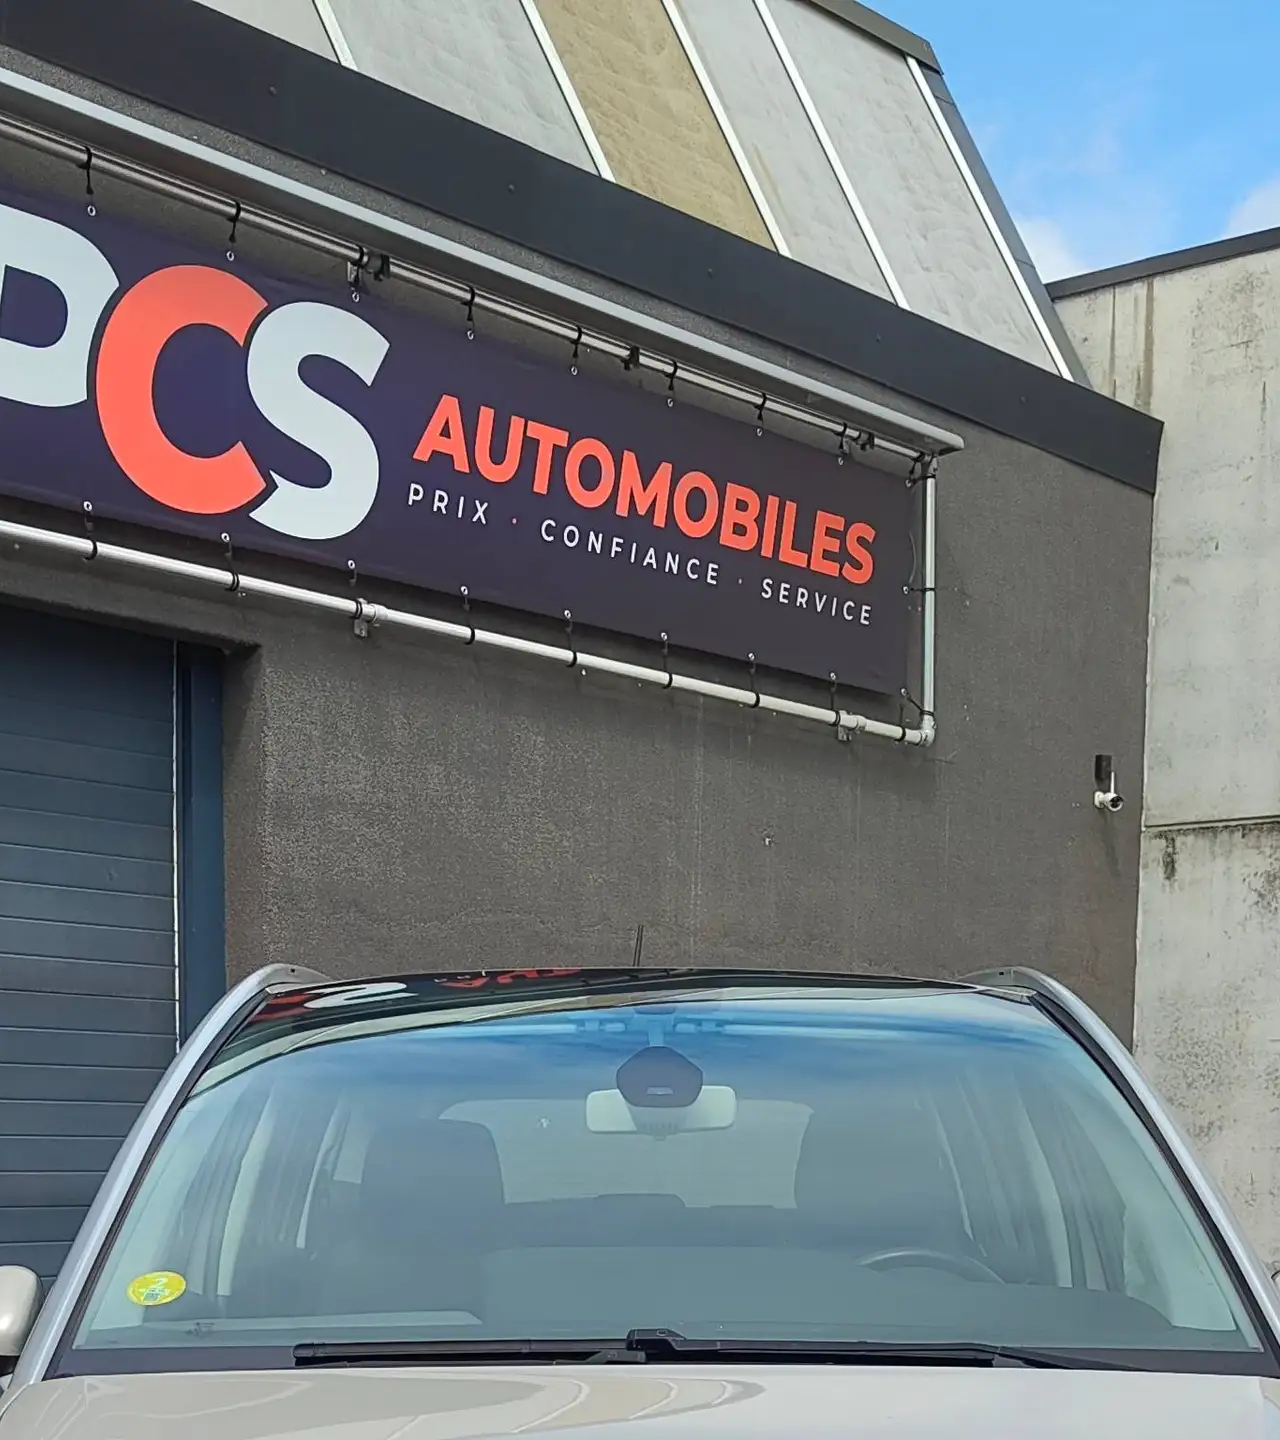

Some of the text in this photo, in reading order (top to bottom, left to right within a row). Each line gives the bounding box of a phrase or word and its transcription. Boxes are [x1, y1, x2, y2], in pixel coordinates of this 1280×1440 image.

[408, 483, 872, 624] PRIX CONFIANCE SERVICE
[412, 396, 874, 583] AUTOMOBILES
